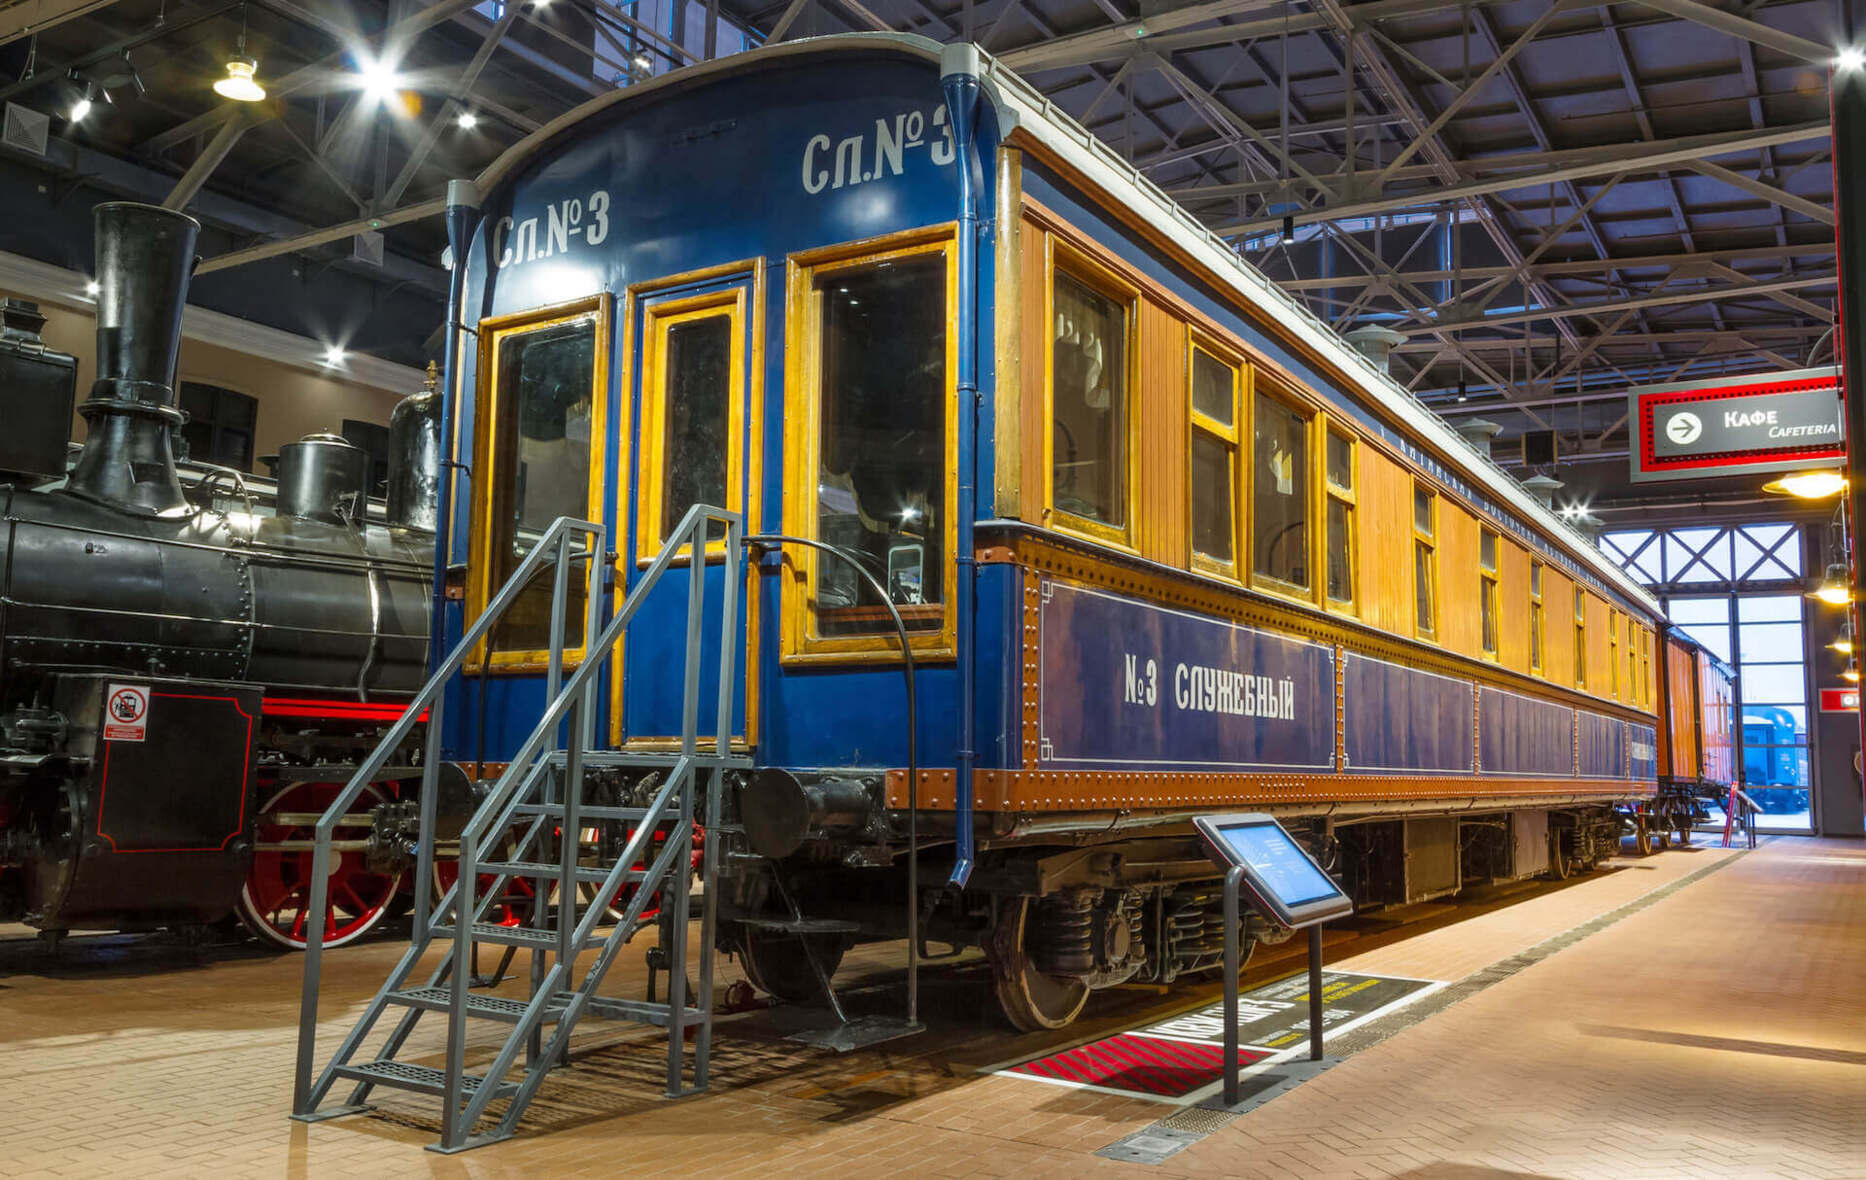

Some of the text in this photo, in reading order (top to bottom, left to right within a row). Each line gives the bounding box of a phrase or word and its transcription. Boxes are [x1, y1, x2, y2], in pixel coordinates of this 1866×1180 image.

[1724, 410, 1778, 428] КАФЕ
[1769, 424, 1836, 438] CAFETERIA
[1125, 654, 1294, 720] №3 СЛУЖЕБНЫЙ
